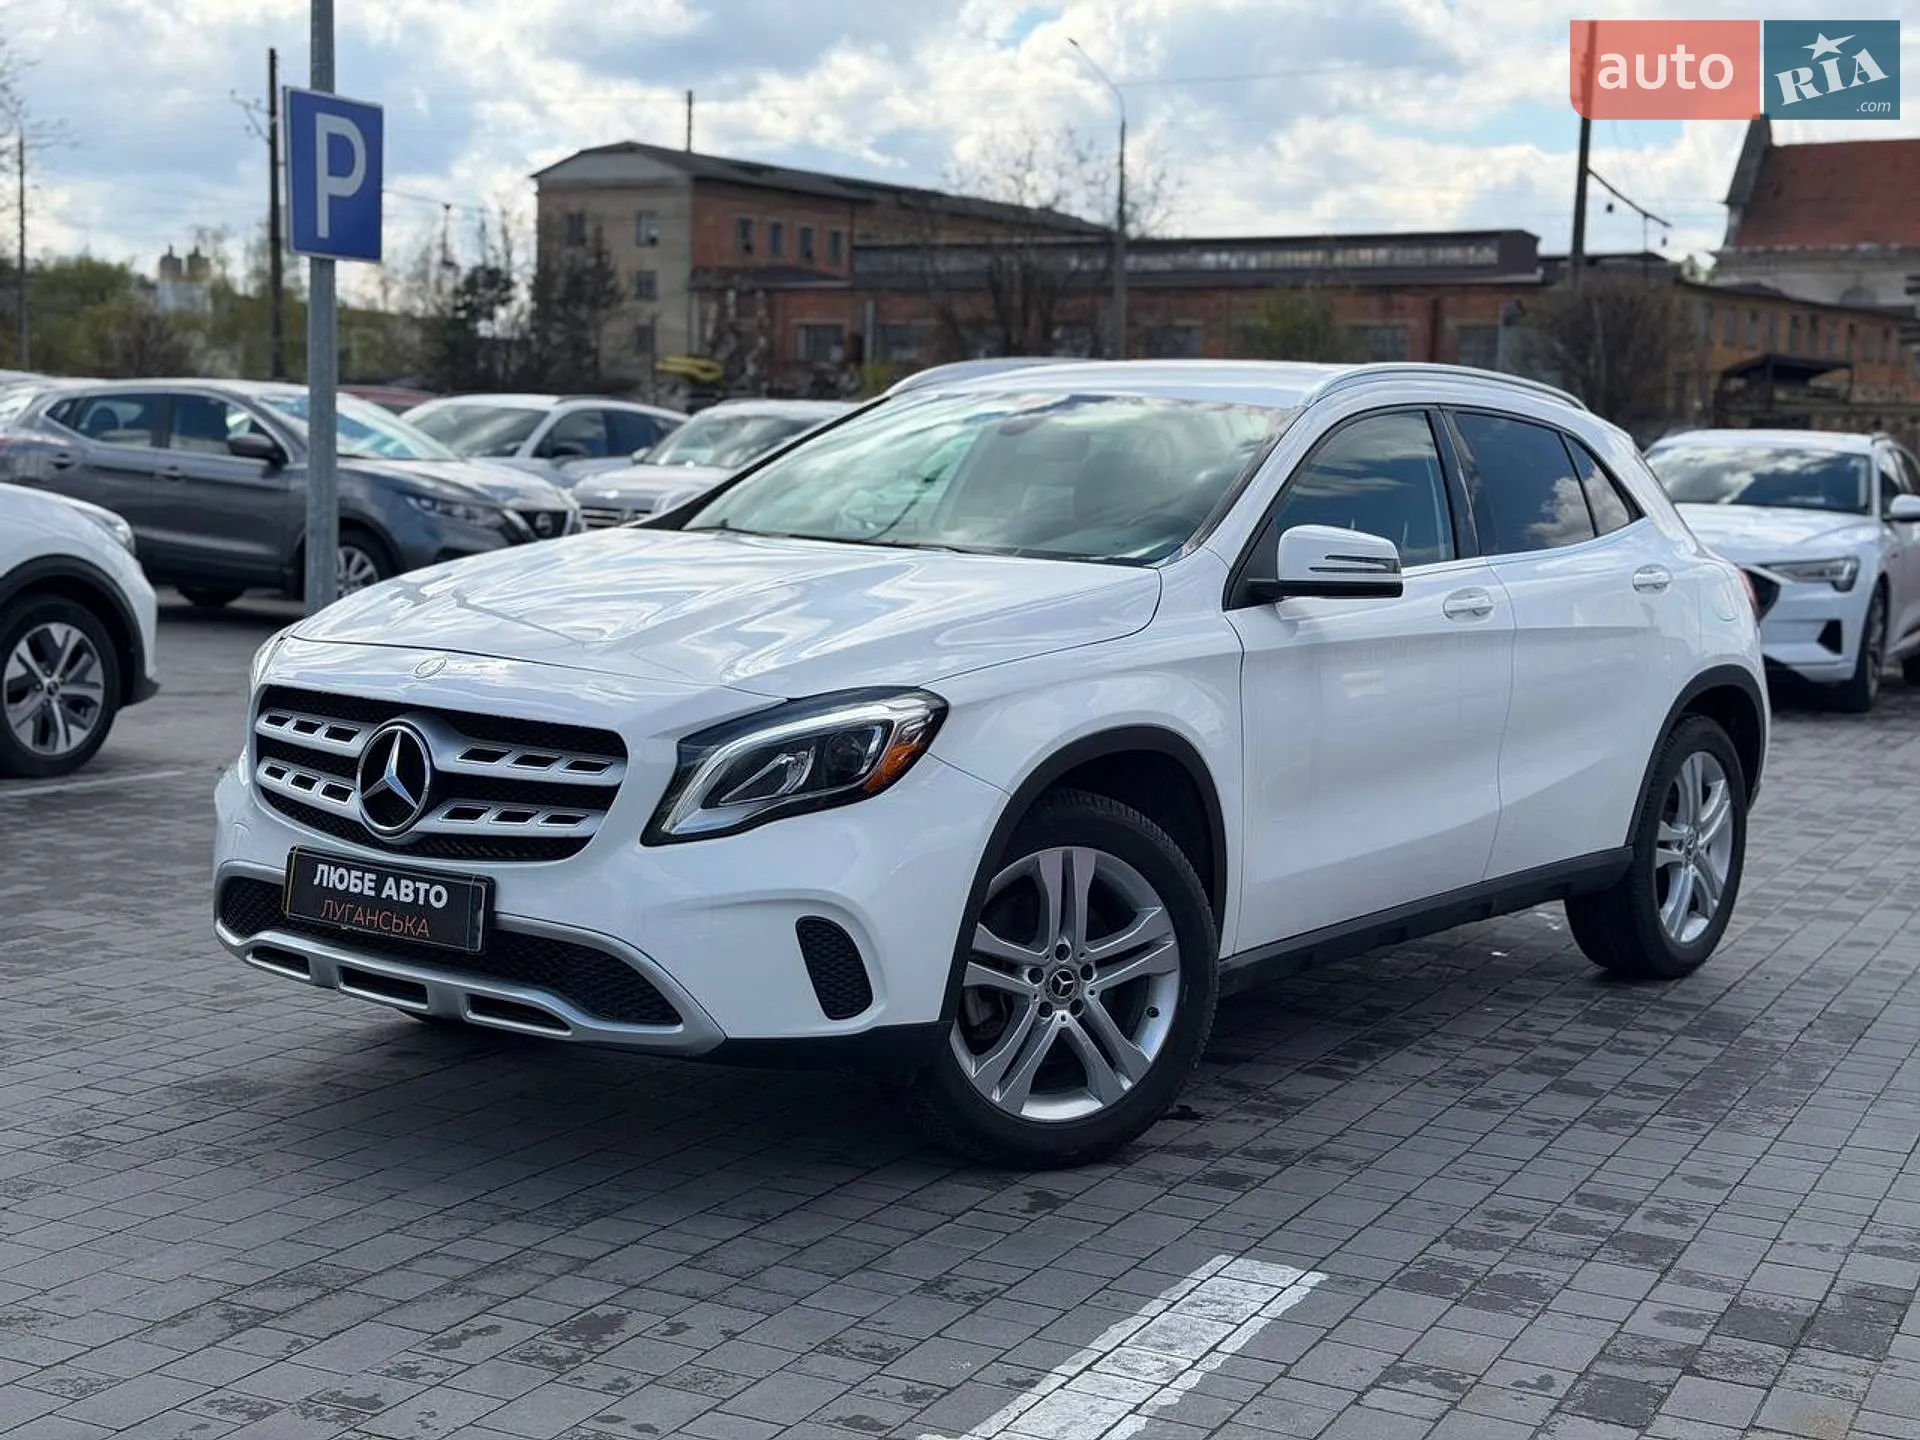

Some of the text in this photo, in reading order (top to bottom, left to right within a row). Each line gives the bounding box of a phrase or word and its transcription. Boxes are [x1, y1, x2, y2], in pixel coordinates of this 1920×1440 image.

[315, 112, 367, 239] P
[313, 863, 448, 909] ЛЮБЕ АВТО
[320, 899, 430, 938] ЛУГАНСЬКА
